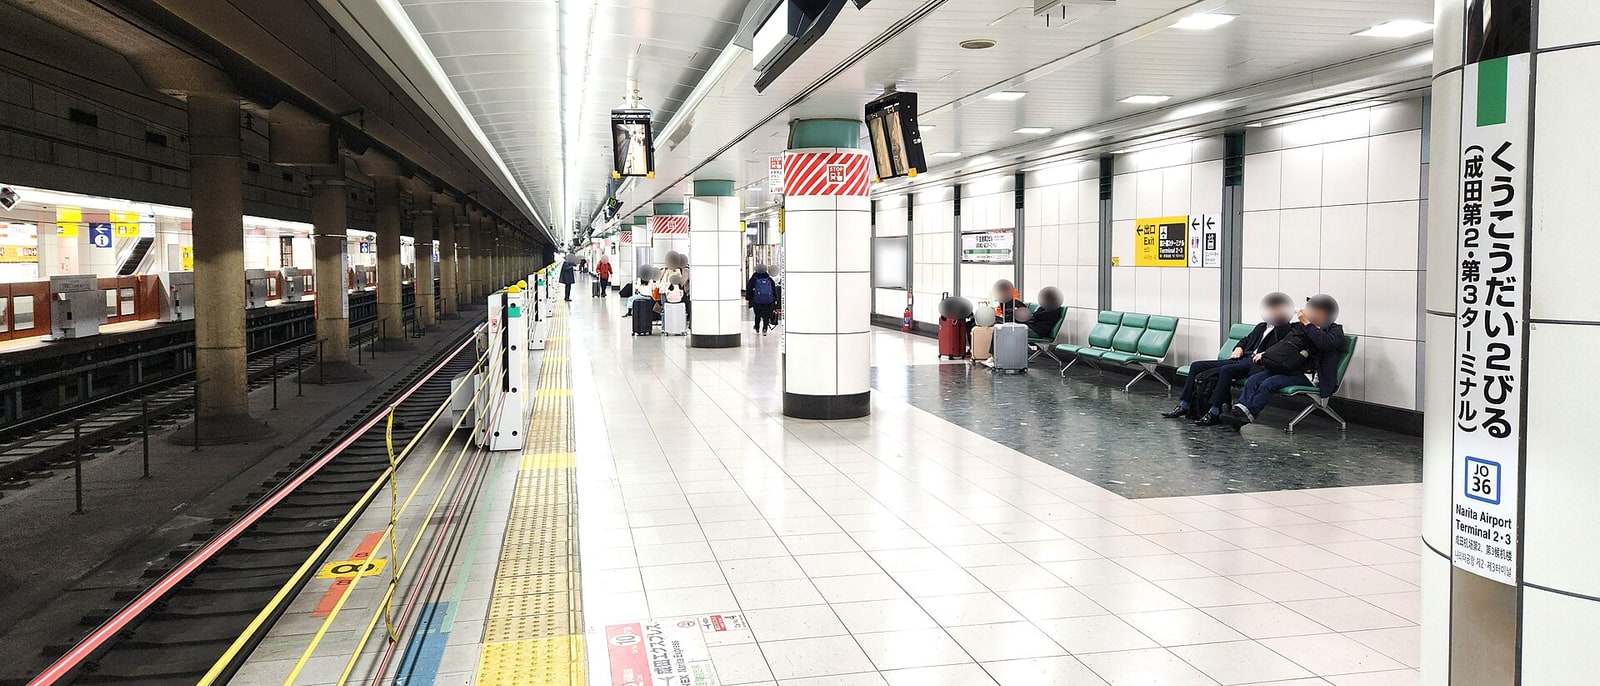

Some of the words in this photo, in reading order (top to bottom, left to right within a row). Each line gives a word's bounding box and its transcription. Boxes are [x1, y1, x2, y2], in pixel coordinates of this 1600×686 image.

[1144, 236, 1154, 245] Exit
[1481, 140, 1516, 440] くうこうだい2びる
[1473, 463, 1489, 478] JO
[1472, 476, 1491, 495] 36
[1456, 503, 1478, 521] Narita
[1479, 511, 1512, 529] Airport
[1456, 519, 1491, 540] Terminal
[331, 563, 375, 575] 8
[616, 635, 636, 645] 10
[646, 622, 673, 675] 成田エクスプレス
